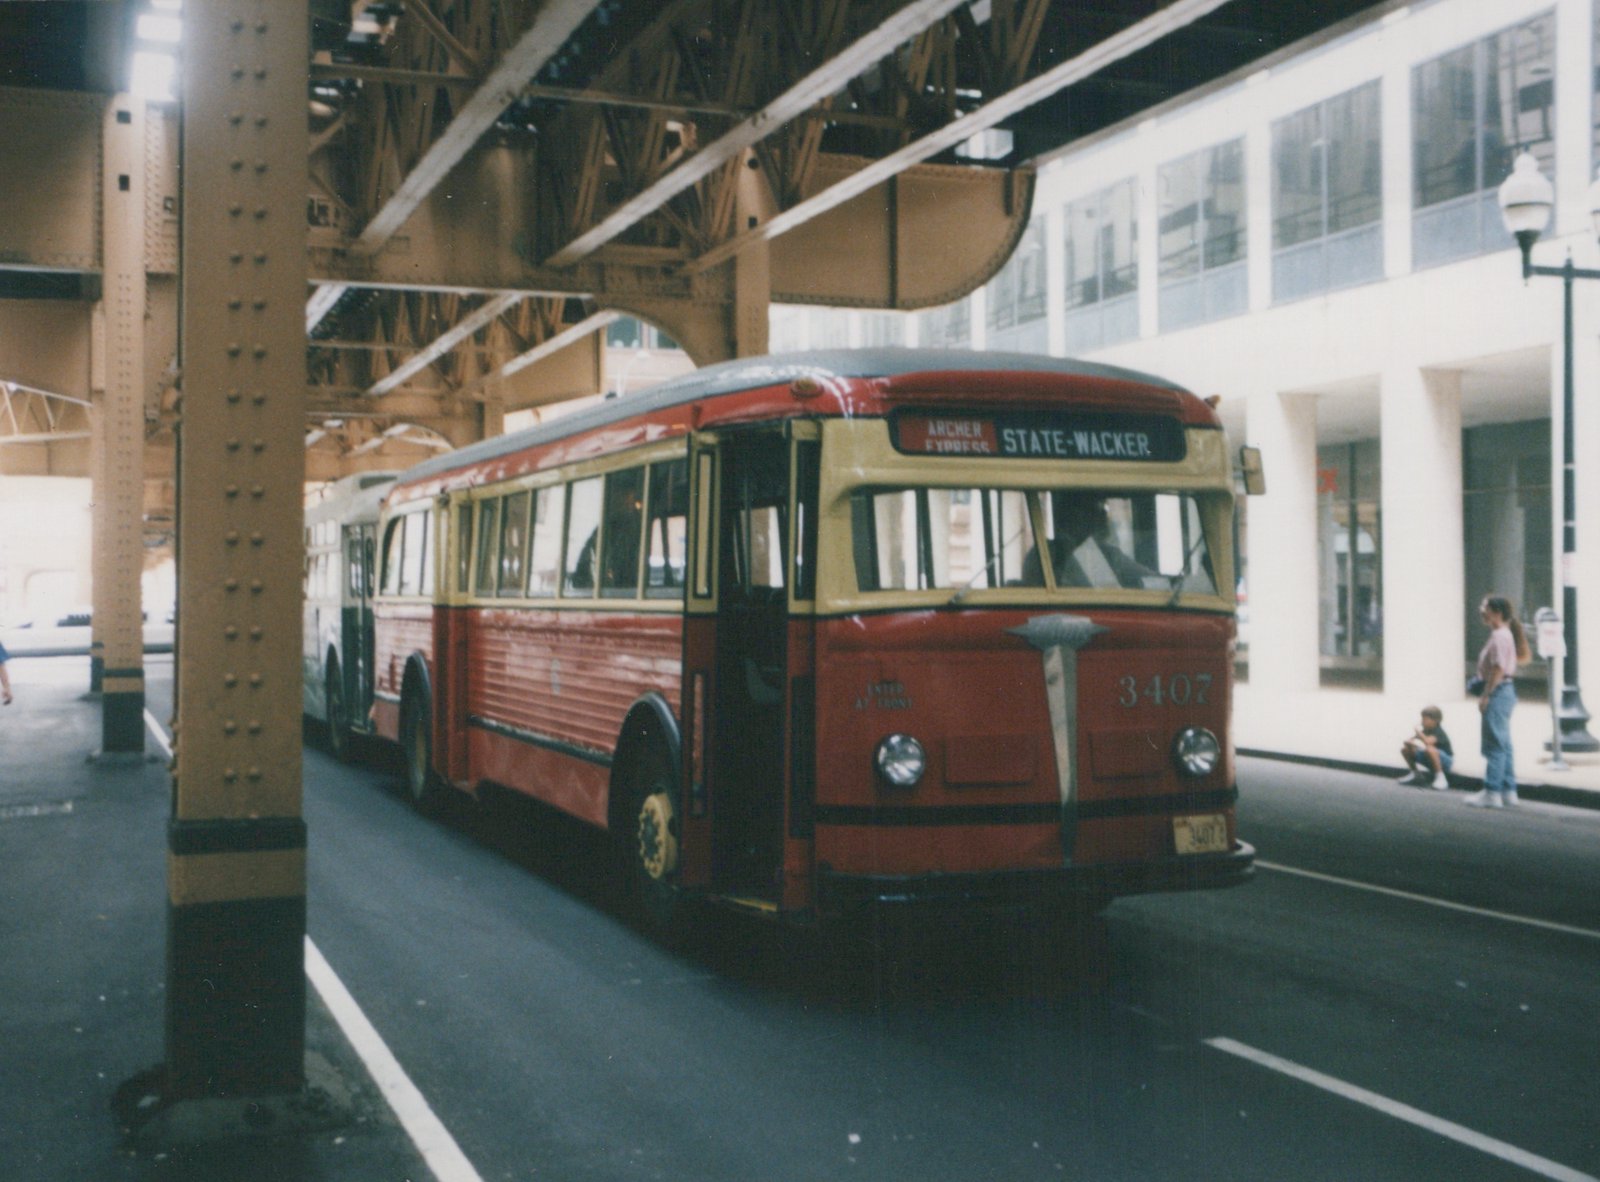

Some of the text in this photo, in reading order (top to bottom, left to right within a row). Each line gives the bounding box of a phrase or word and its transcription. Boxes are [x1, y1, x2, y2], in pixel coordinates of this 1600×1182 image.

[928, 420, 982, 437] ARCHER
[1002, 428, 1151, 456] STATE-WACKER
[1118, 672, 1213, 708] 3407
